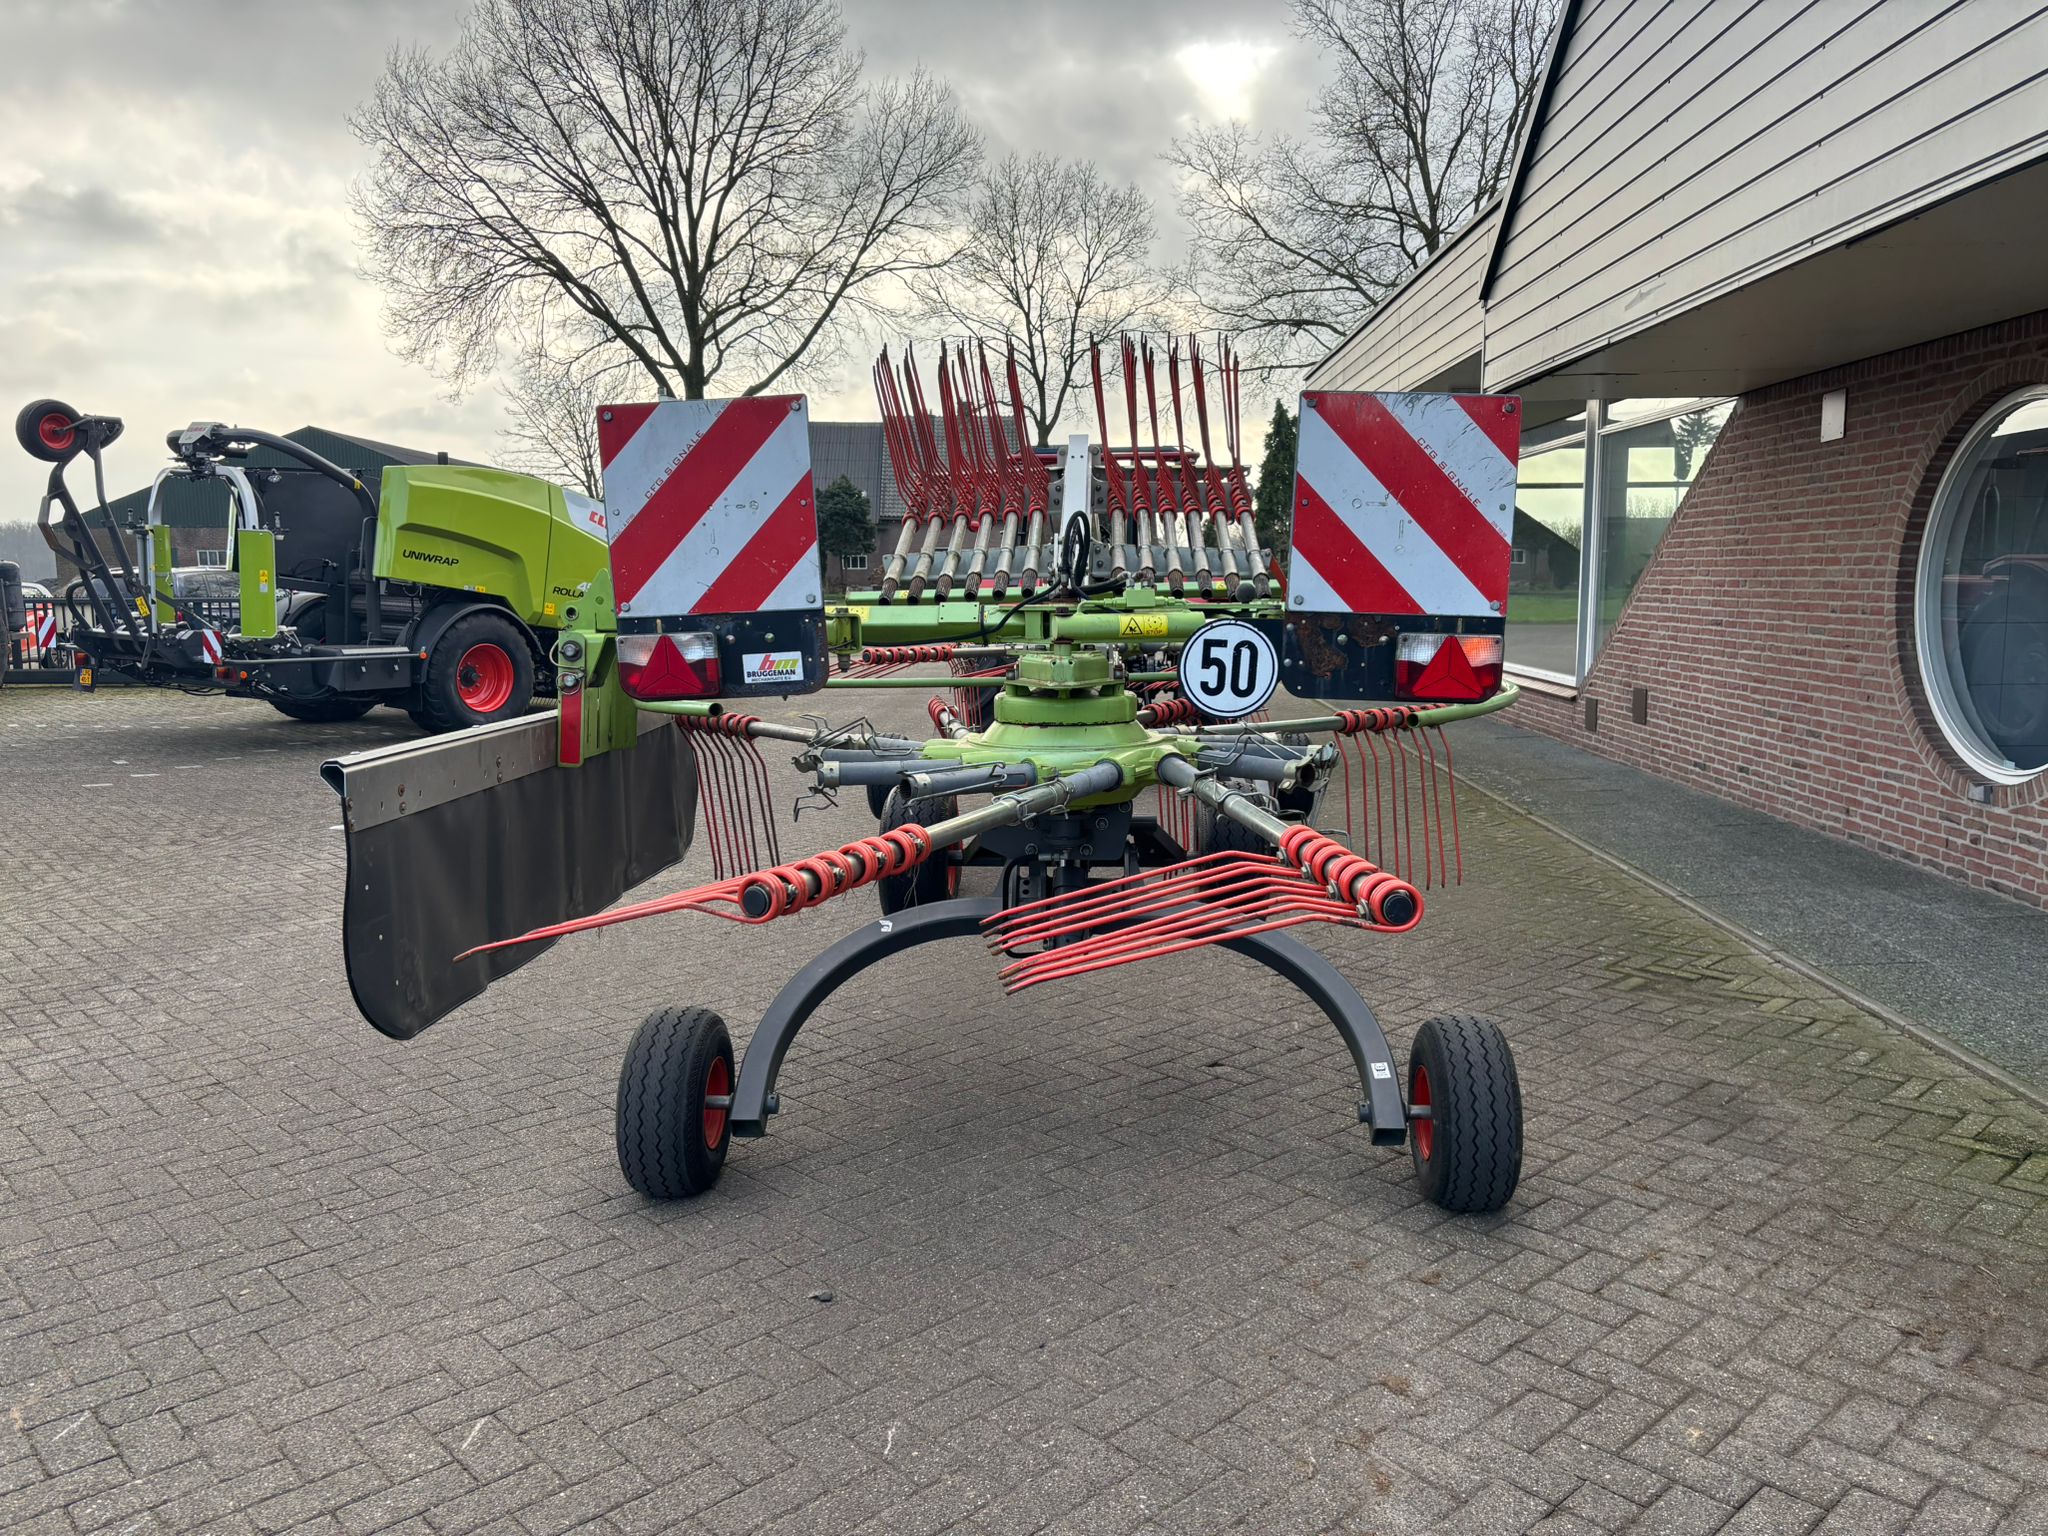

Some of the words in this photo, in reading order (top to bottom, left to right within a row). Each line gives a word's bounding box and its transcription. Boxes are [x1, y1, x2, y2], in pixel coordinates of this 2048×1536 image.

[644, 477, 664, 500] CFG
[664, 430, 704, 476] SIGNALE
[1416, 437, 1438, 460] CFG
[1438, 461, 1481, 507] SIGNALE
[403, 549, 459, 567] UNIWRAP
[746, 669, 796, 678] BRUGGEMAN
[1200, 639, 1259, 698] 50
